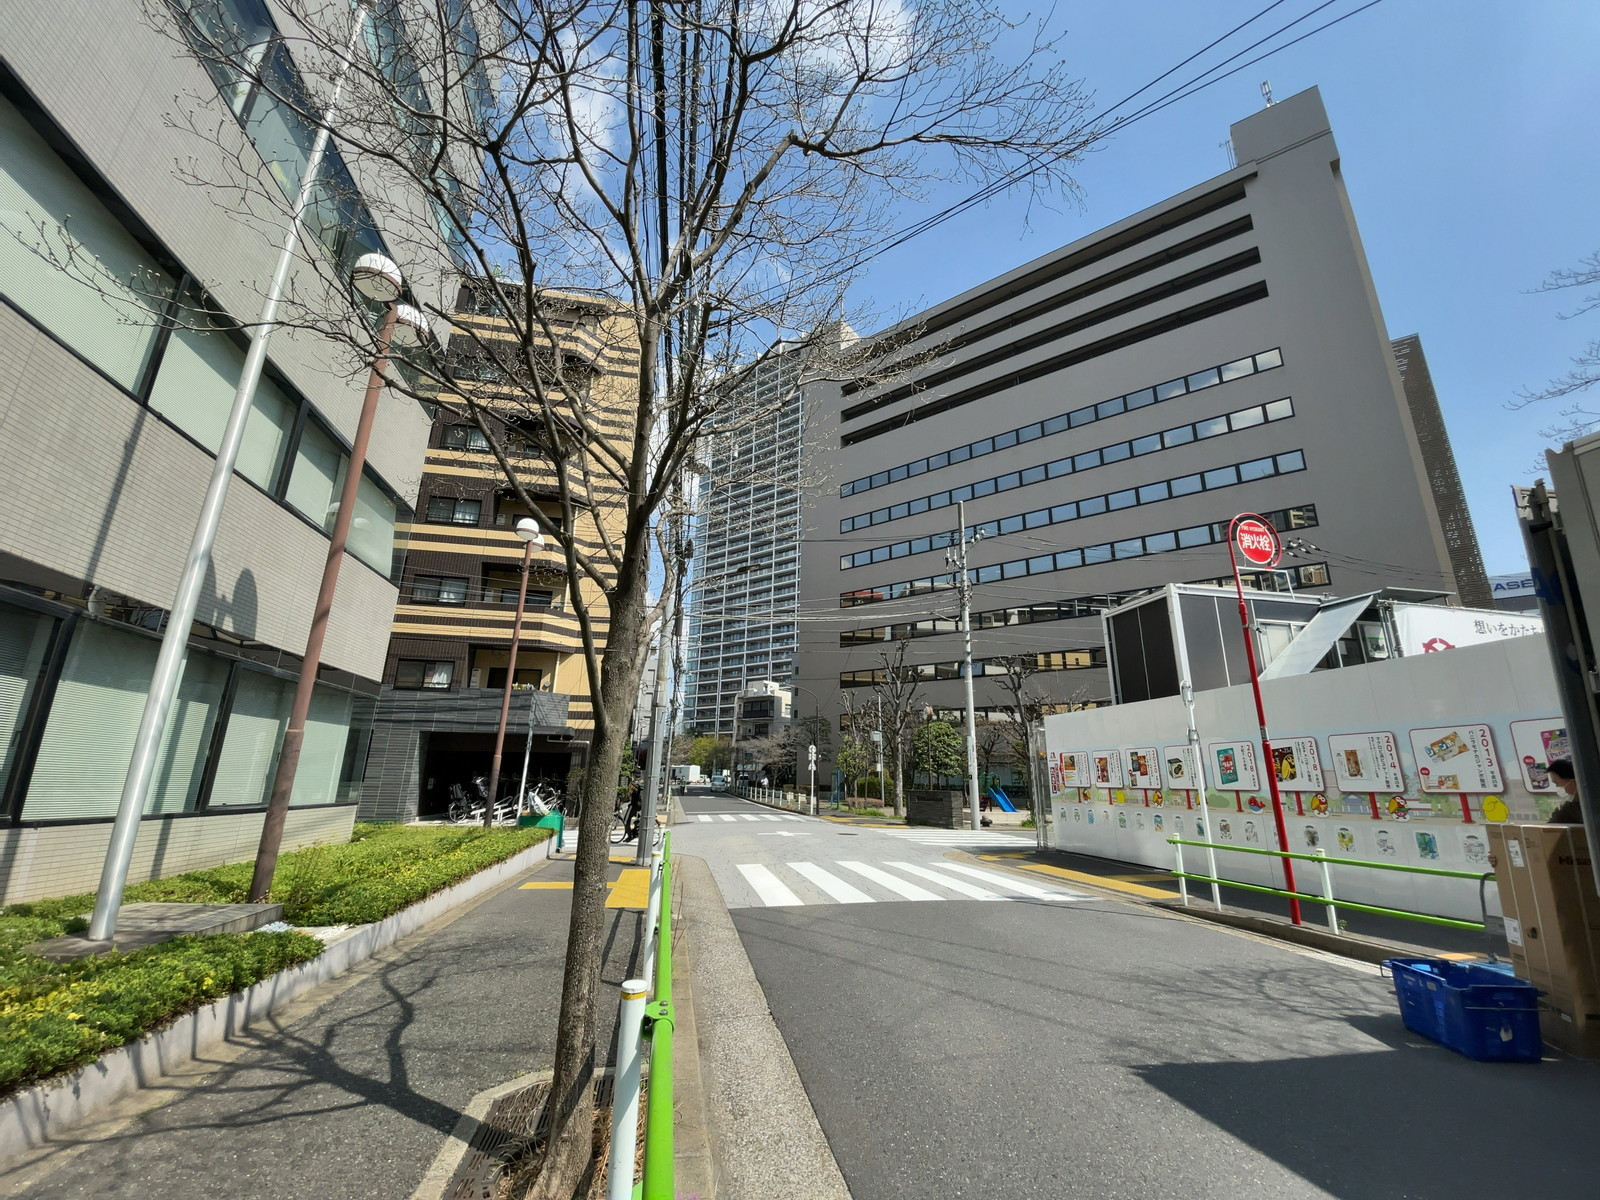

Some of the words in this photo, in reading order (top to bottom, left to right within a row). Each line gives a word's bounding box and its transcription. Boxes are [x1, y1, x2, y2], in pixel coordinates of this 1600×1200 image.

[1240, 533, 1271, 551] 消火栓
[1473, 619, 1544, 637] 想いをかたち
[1246, 745, 1255, 772] 2018
[1308, 740, 1318, 771] 2018
[1384, 735, 1397, 769] 2014
[1479, 728, 1494, 767] 2013
